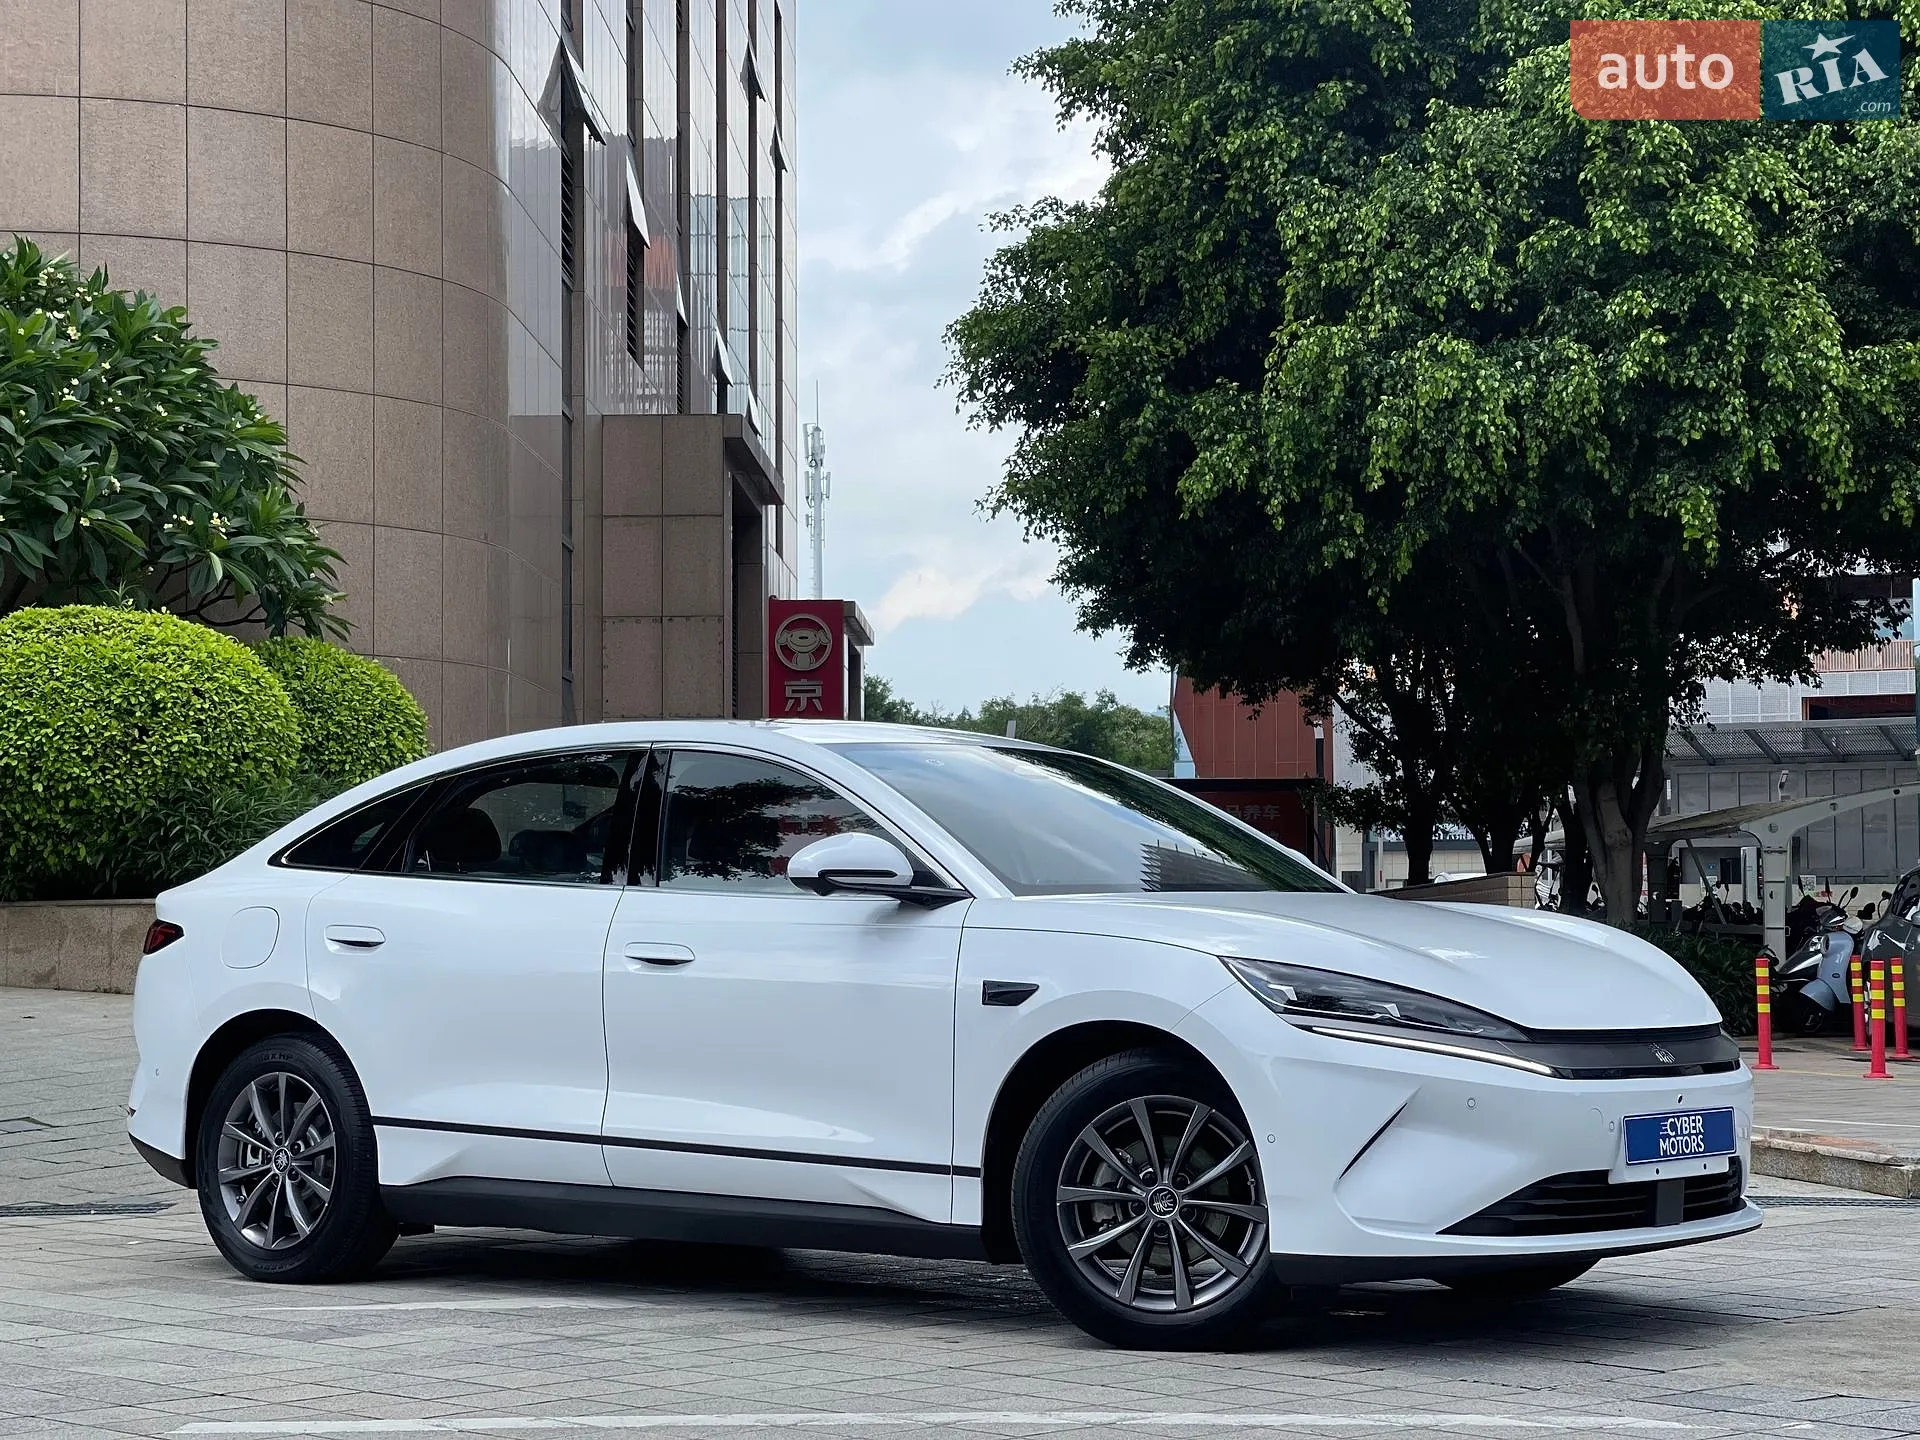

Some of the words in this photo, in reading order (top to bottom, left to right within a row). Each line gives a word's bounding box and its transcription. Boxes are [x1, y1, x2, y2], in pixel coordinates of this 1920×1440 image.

[784, 679, 823, 712] 京
[1666, 1115, 1705, 1136] CYBER
[1659, 1134, 1705, 1156] MOTORS
